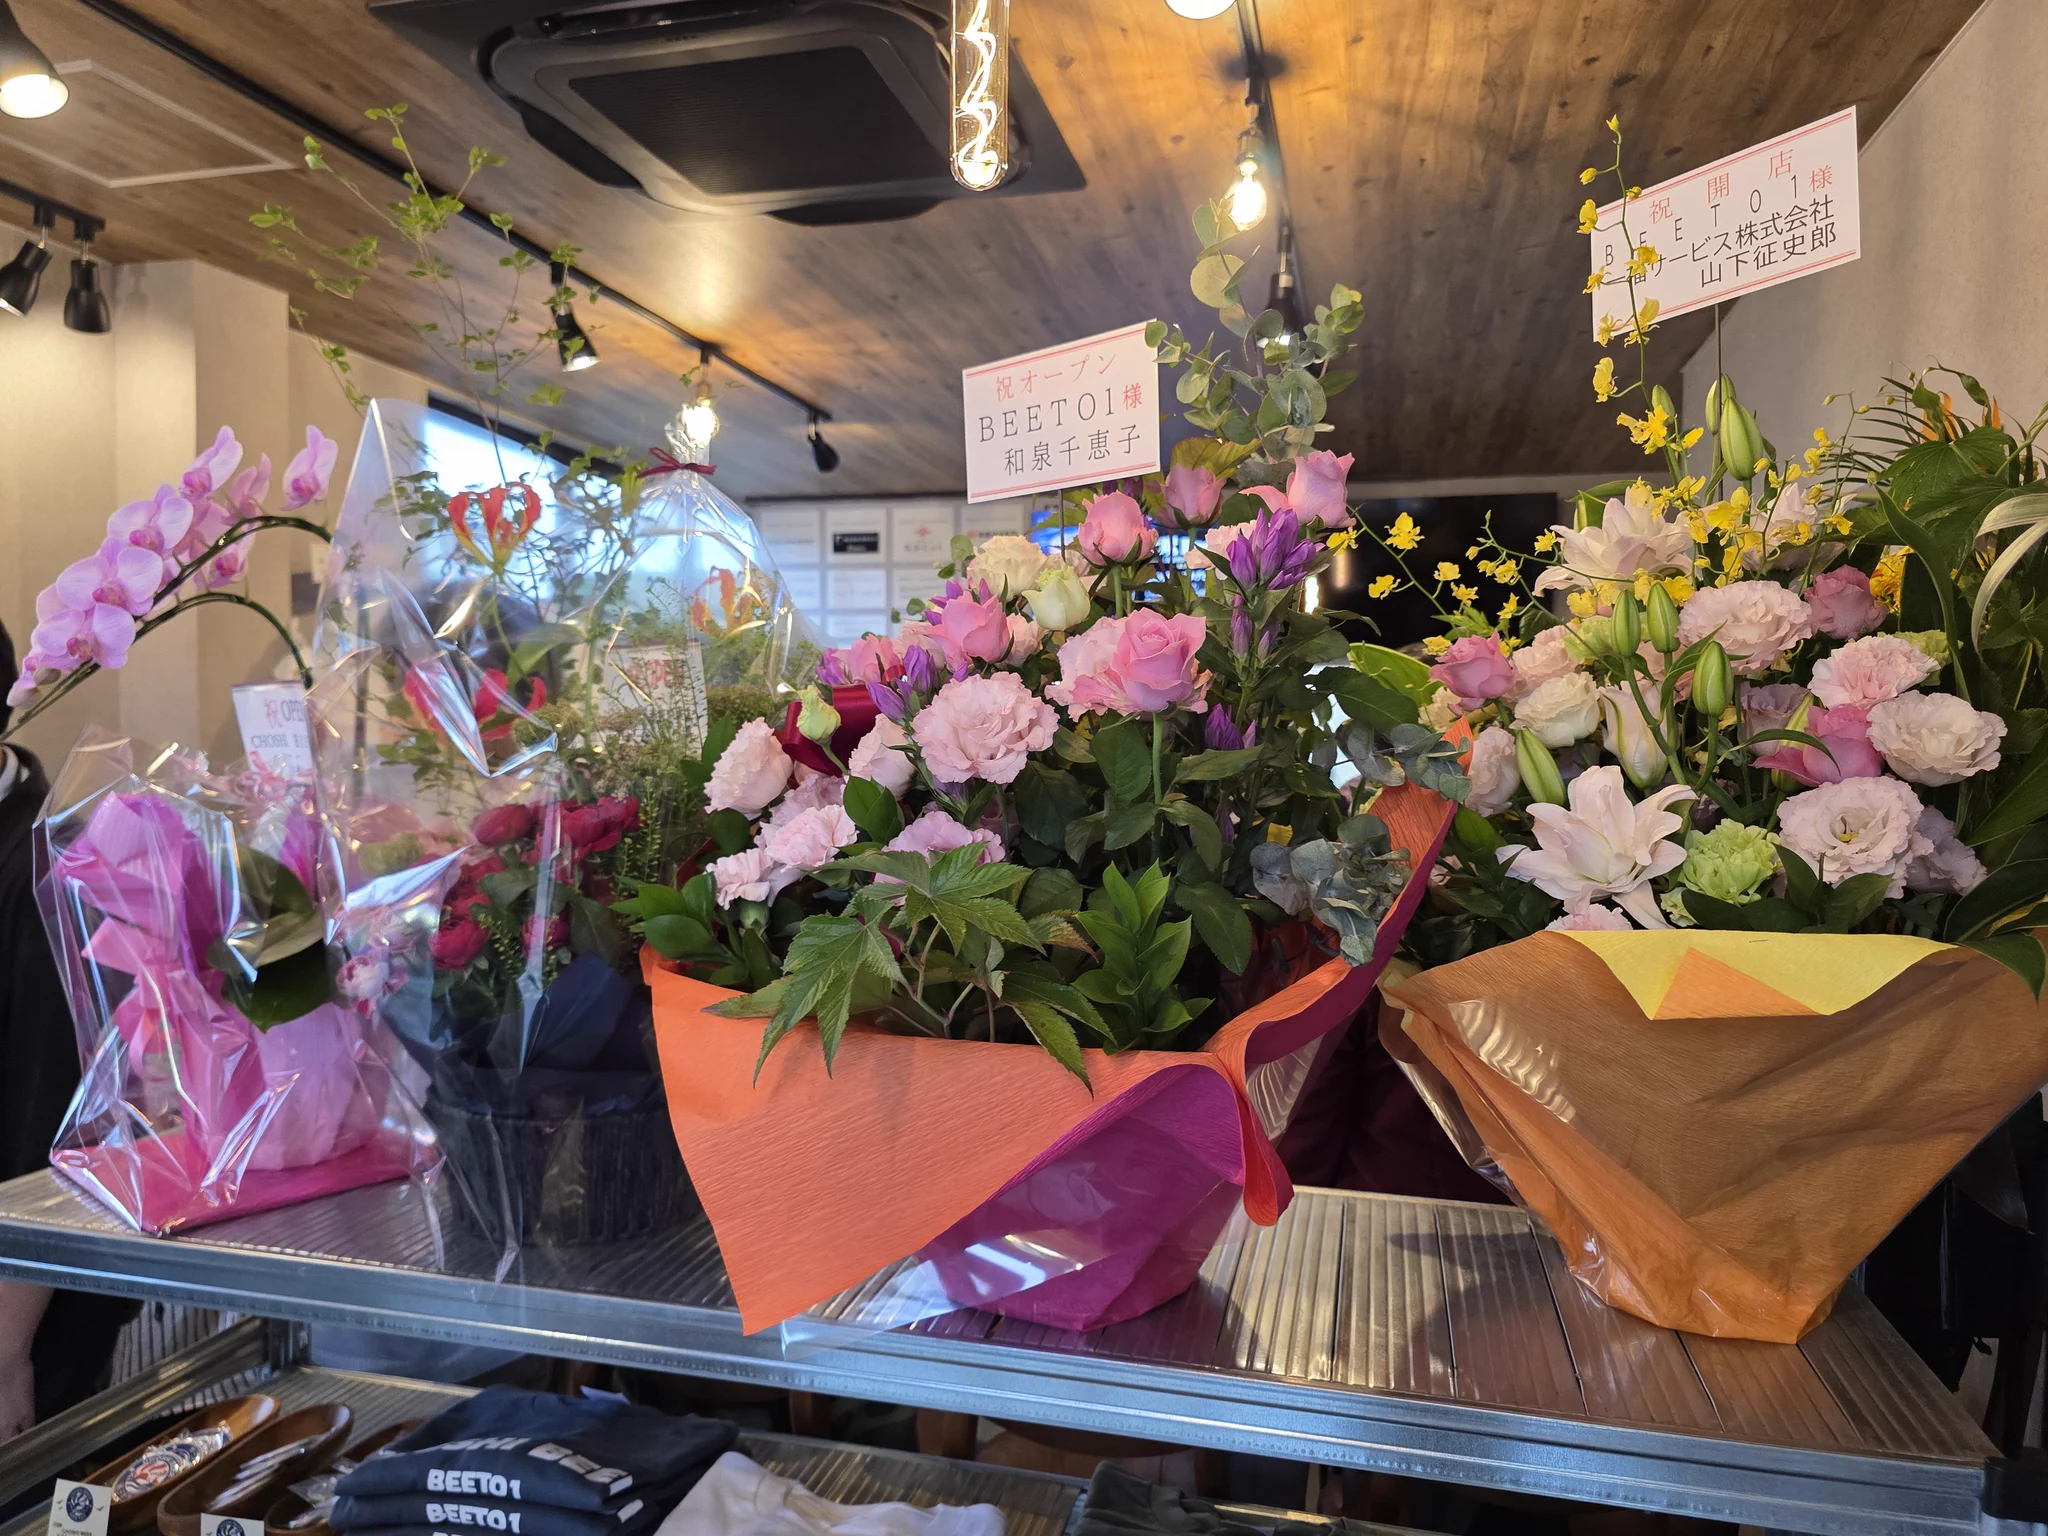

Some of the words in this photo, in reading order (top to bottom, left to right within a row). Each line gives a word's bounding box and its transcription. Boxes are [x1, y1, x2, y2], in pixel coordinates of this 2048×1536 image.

[1649, 149, 1794, 225] 祝開店
[1701, 221, 1837, 288] 山下征史郎
[996, 353, 1117, 403] 祝オープン
[1004, 424, 1141, 477] 和泉千恵子
